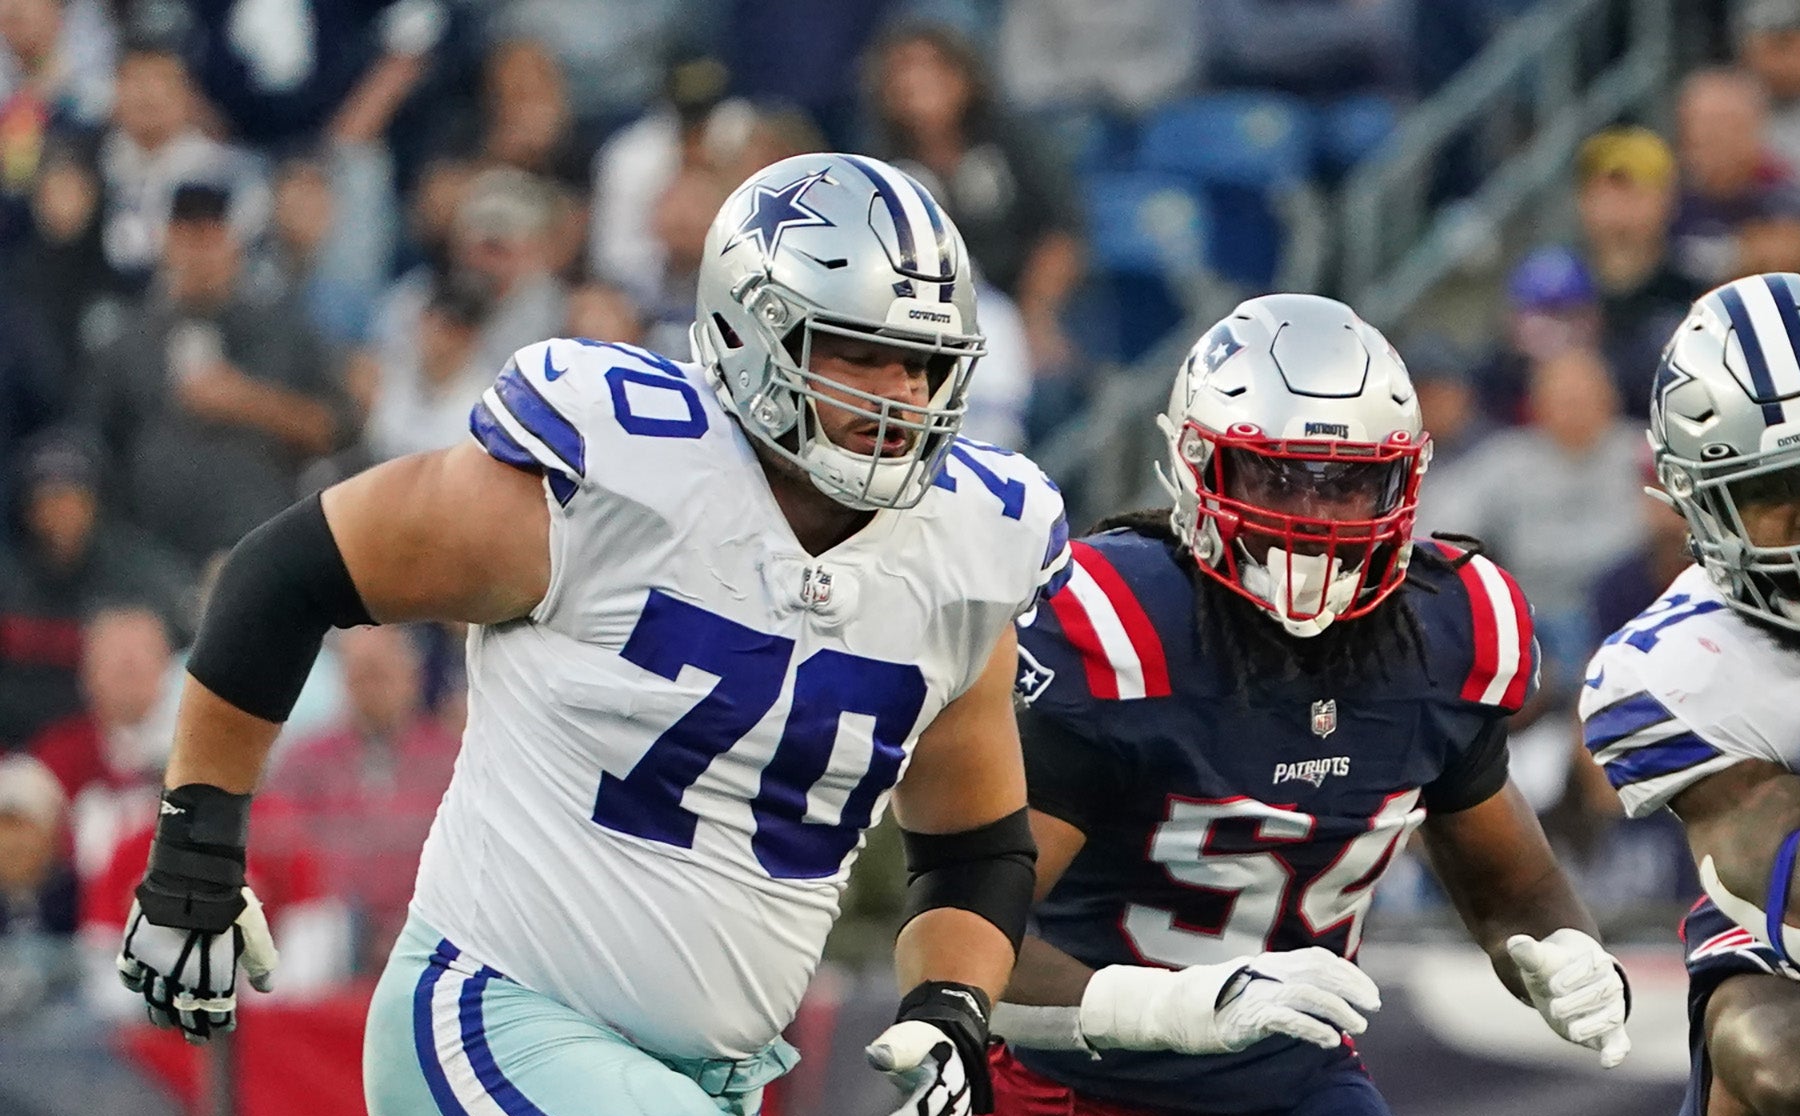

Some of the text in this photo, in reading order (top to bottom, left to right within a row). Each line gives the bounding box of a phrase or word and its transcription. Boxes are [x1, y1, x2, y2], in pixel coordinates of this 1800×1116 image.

[1304, 422, 1350, 440] PATRIOTS
[590, 586, 929, 880] 70
[1272, 756, 1351, 785] PATRIOTS
[1117, 786, 1427, 972] 54
